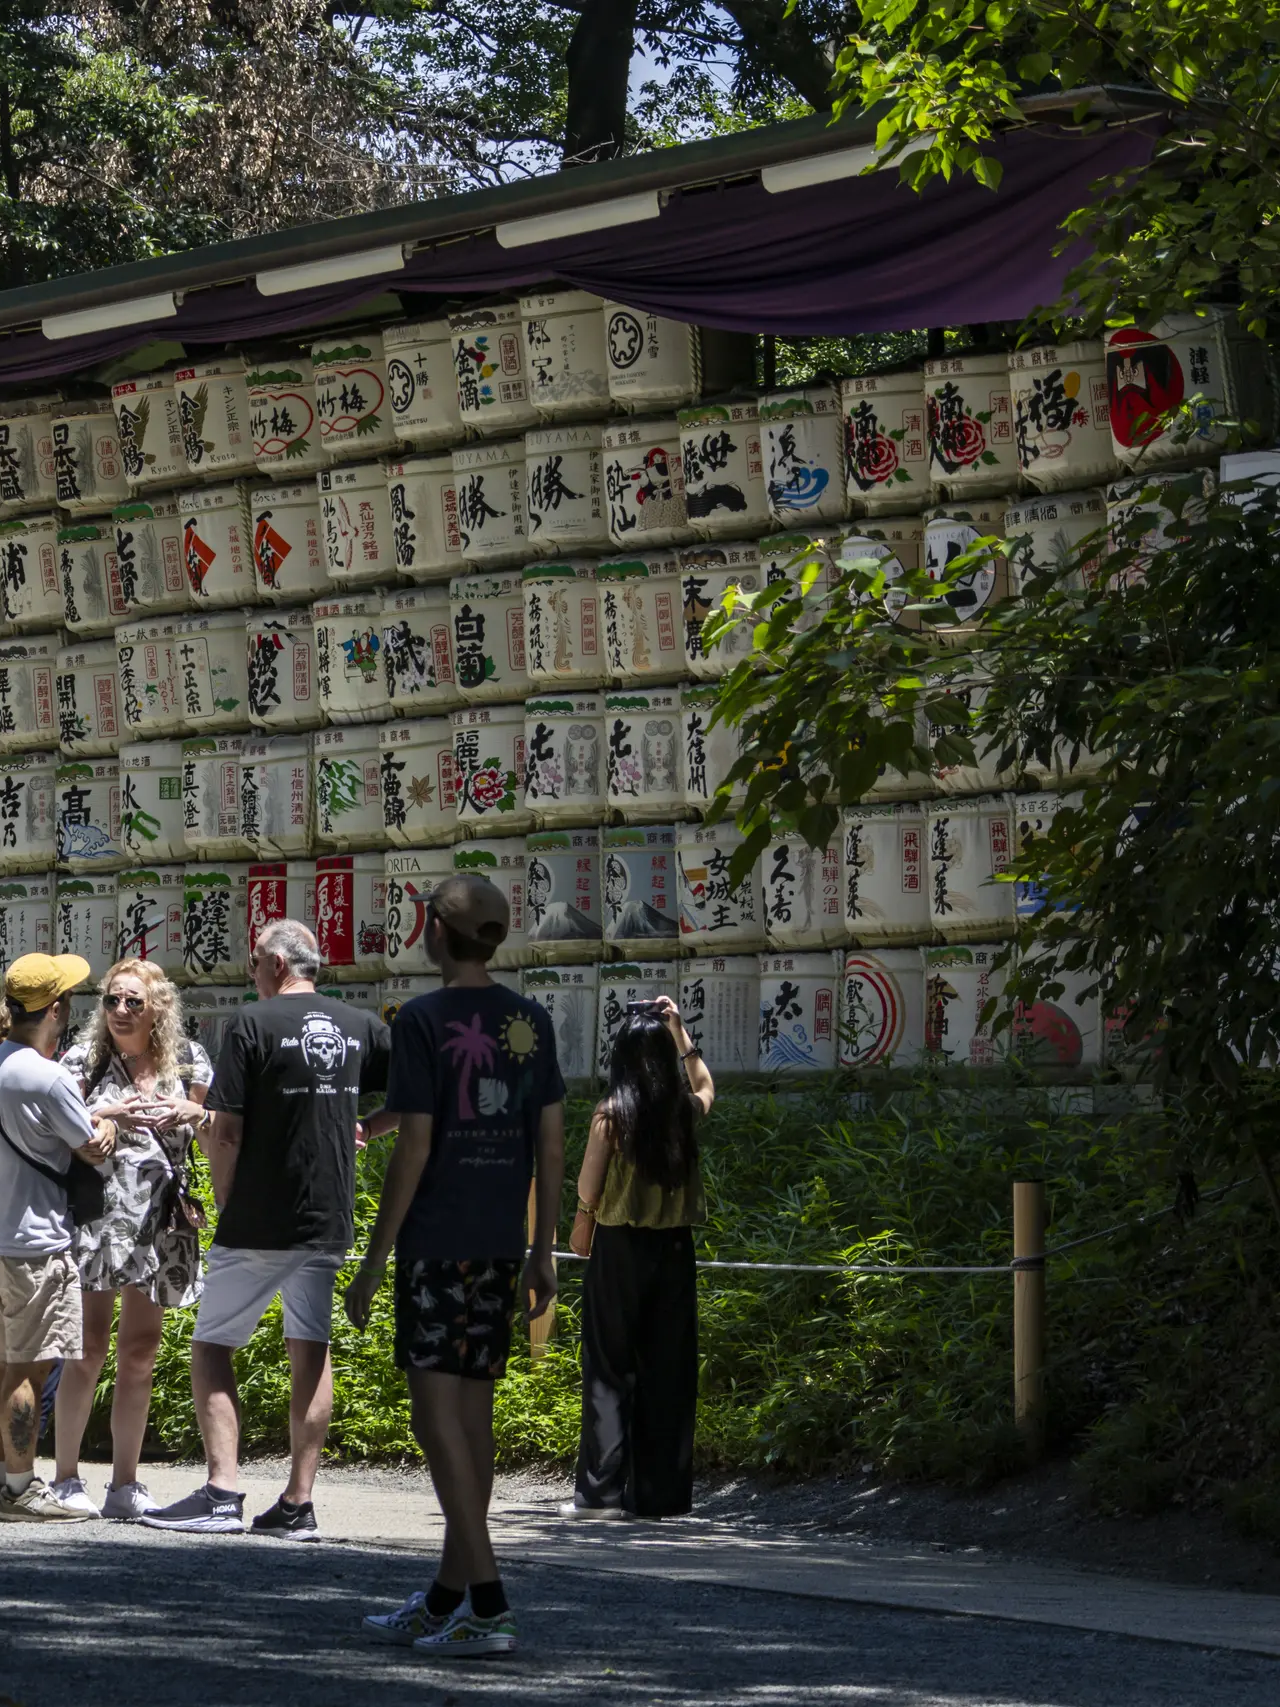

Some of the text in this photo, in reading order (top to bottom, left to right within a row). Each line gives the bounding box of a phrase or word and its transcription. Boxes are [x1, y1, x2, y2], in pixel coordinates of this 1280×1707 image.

[413, 352, 429, 385] 十勝
[1189, 347, 1210, 384] 津軽
[165, 400, 180, 443] キンシ正宗
[224, 386, 240, 432] キンシ正宗
[53, 424, 80, 500] 日本盛
[150, 464, 177, 474] Kyoto
[210, 453, 236, 464] Kyoto
[228, 525, 242, 572] 宮城地の酒
[454, 604, 487, 688] 白菊
[180, 644, 203, 715] 十一正宗
[296, 648, 308, 696] 芳醇清酒
[290, 767, 304, 825] 北信州清酒
[441, 755, 454, 803] 芳醇清酒
[904, 832, 918, 889] 飛騨の酒
[170, 910, 181, 943] 清酒
[388, 878, 402, 958] ねのひ
[816, 994, 831, 1034] 清酒
[281, 1038, 299, 1047] Ride
[212, 1503, 237, 1514] HOKA
